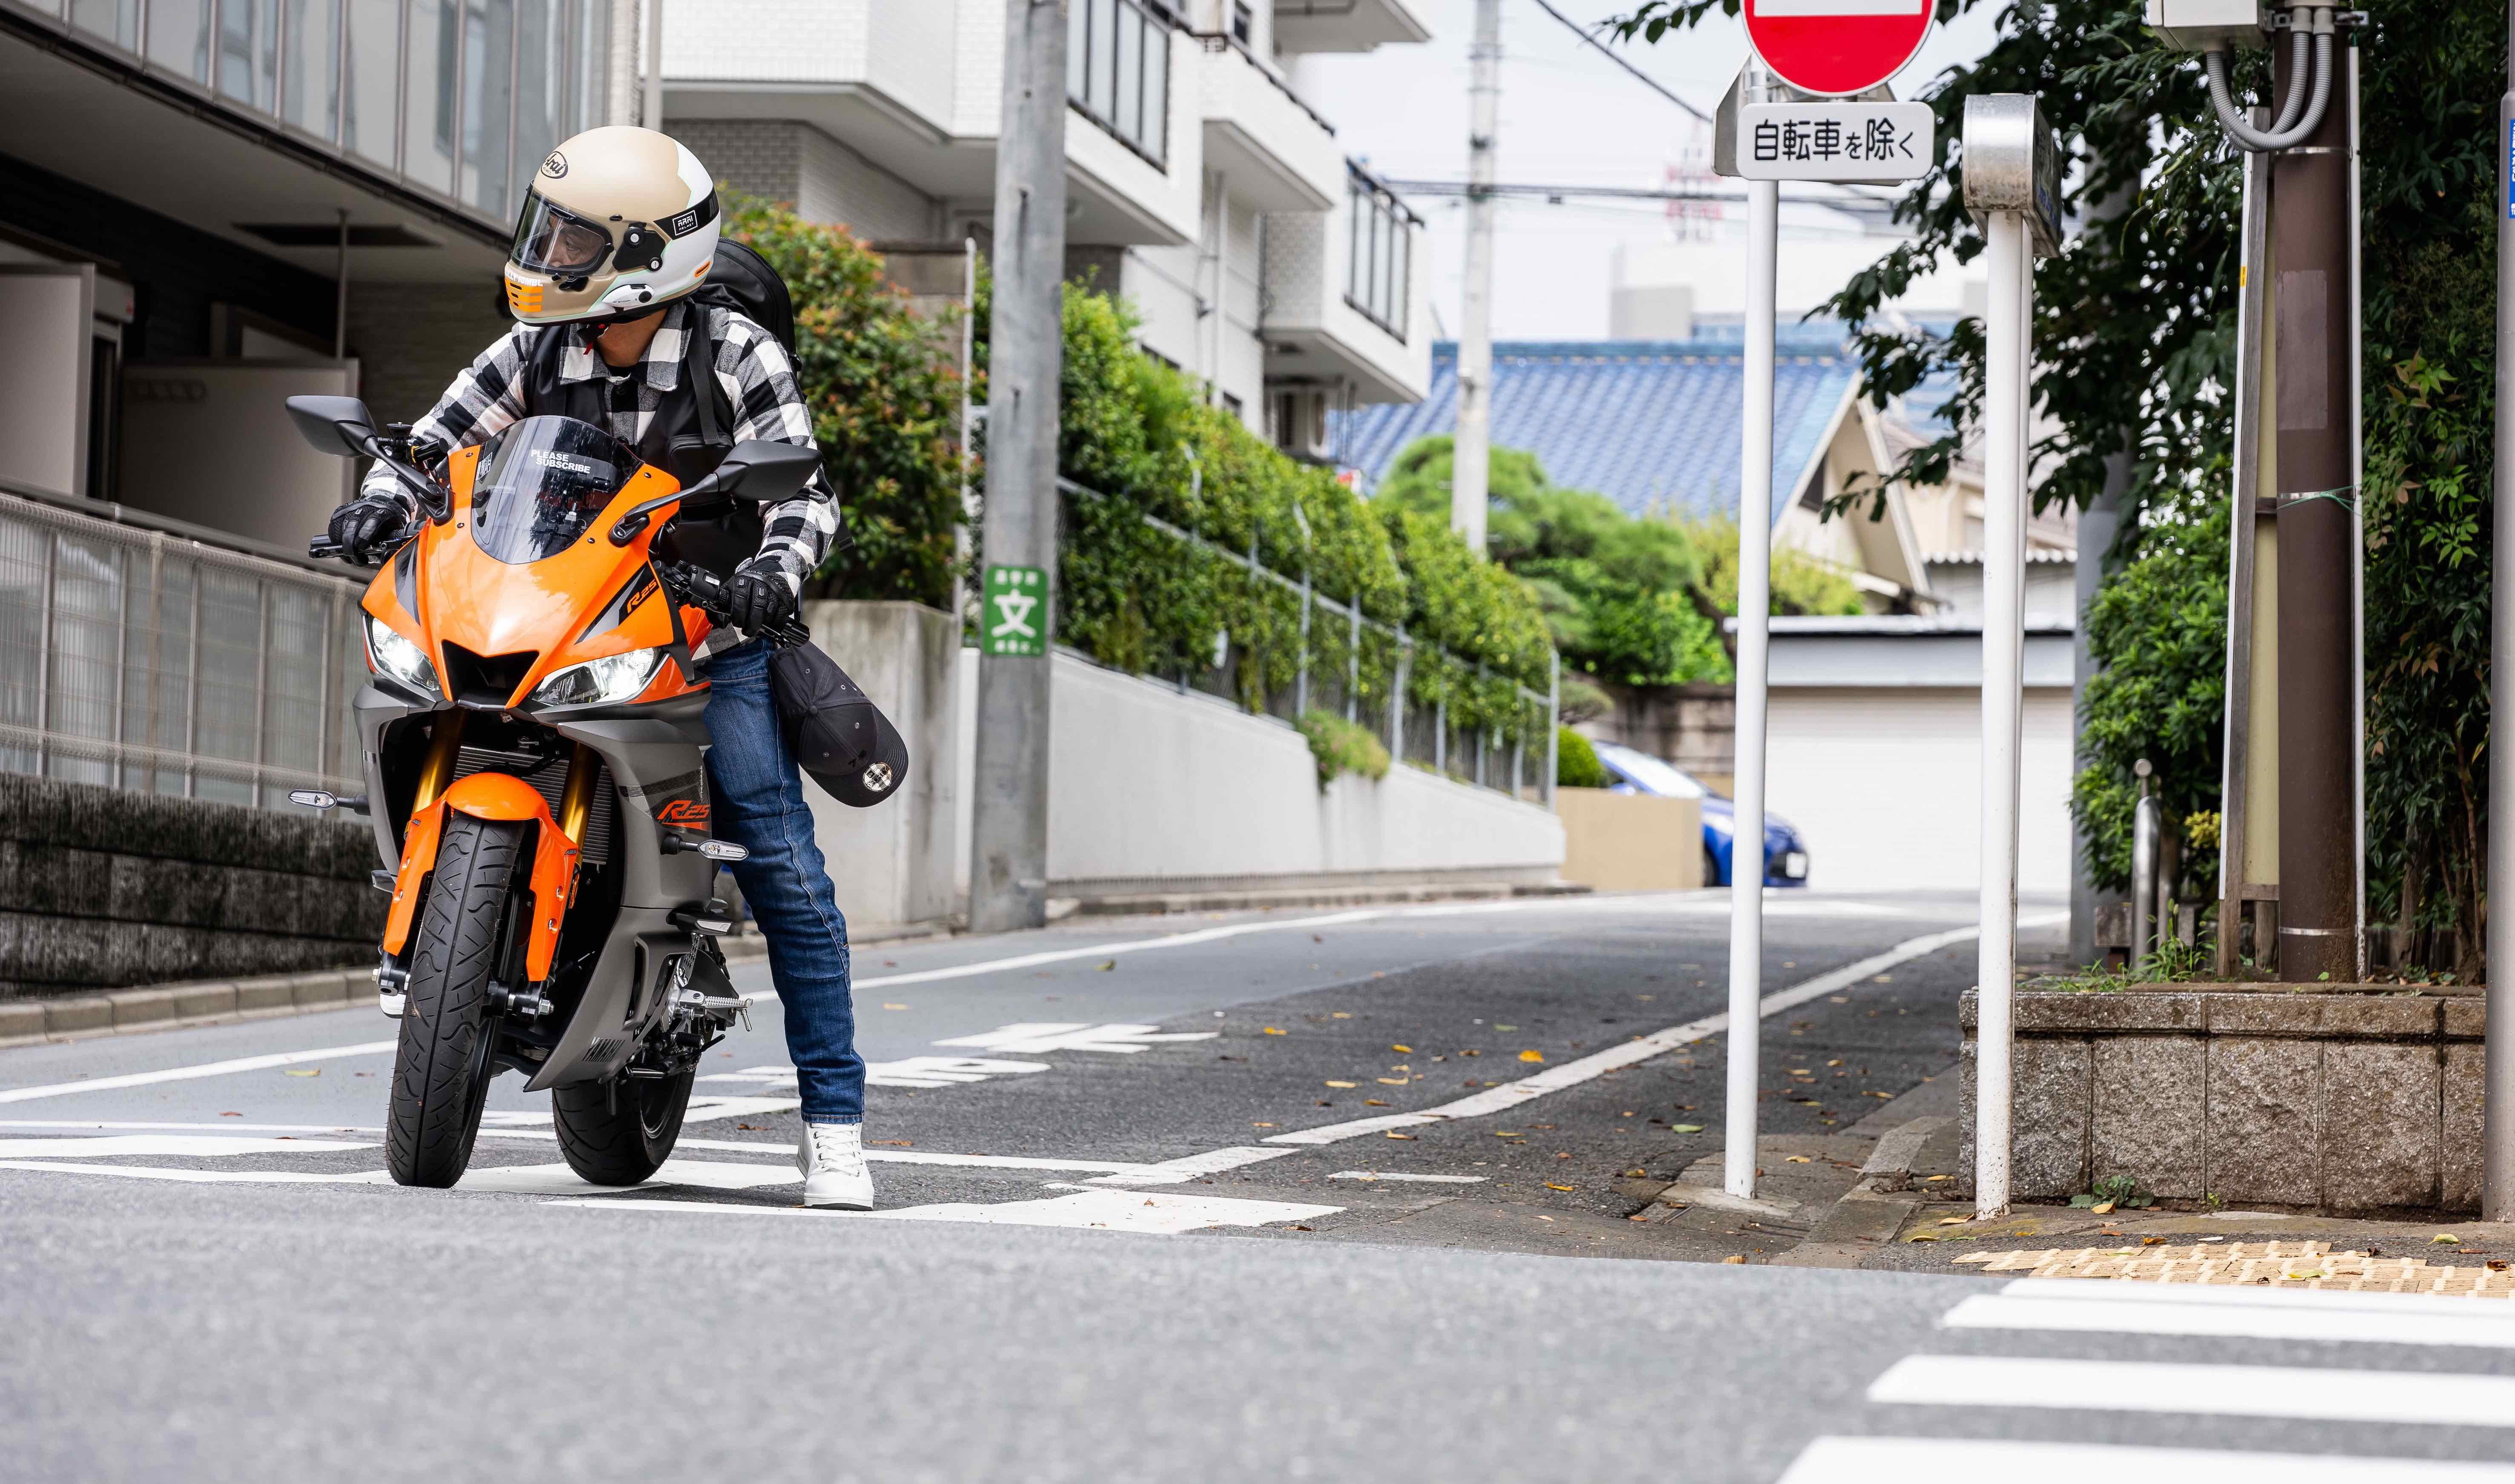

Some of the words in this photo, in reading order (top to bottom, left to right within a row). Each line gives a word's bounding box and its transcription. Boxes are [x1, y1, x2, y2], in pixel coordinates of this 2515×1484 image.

[1754, 117, 1914, 161] 自転車を除く
[678, 215, 693, 227] ARAI
[679, 222, 694, 230] HELMET
[531, 449, 569, 462] PLEASE
[535, 457, 591, 474] SUBSCRIBE
[627, 578, 657, 614] R25
[990, 588, 1038, 638] 文
[657, 800, 710, 819] R25
[581, 1036, 626, 1062] YAMAHA
